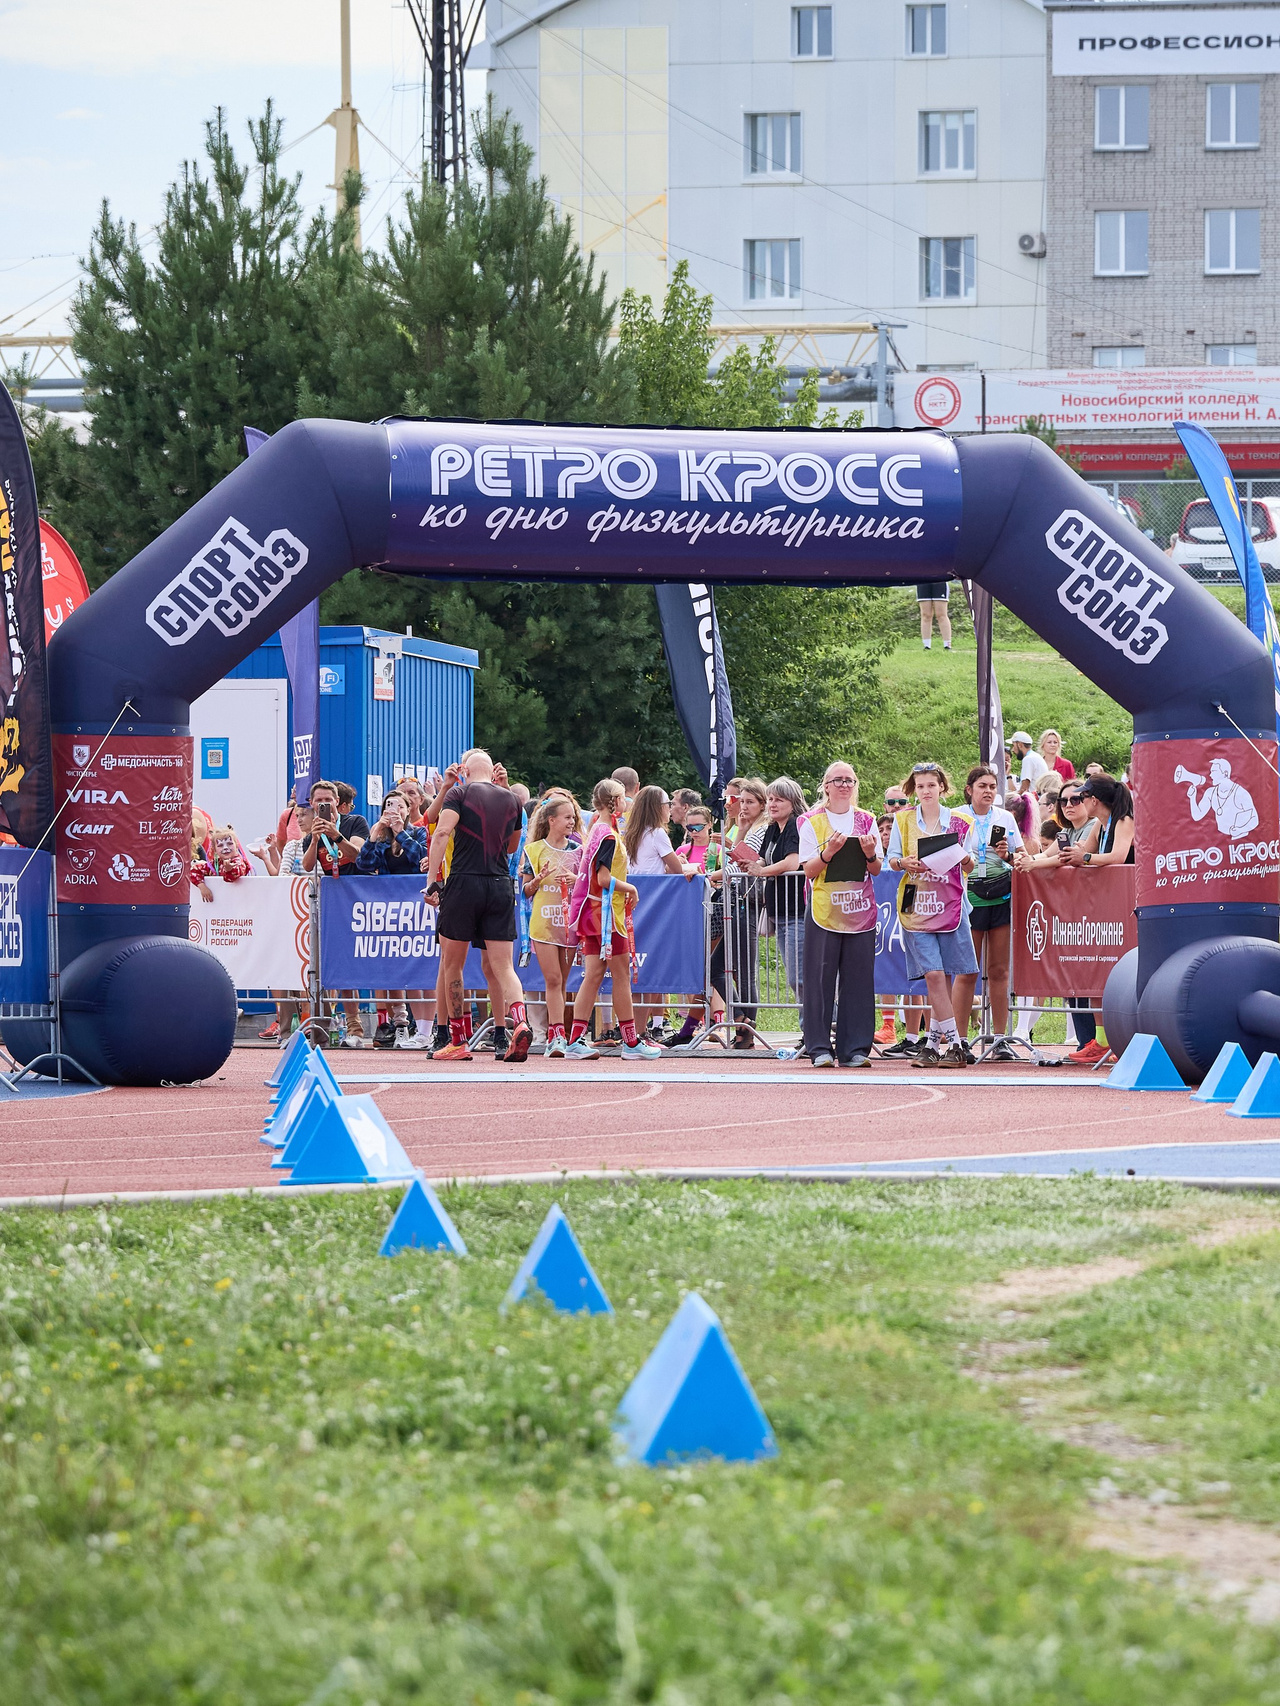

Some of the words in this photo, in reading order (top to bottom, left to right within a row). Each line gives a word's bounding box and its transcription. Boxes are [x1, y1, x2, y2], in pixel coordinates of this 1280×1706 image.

[1062, 392, 1184, 410] Новосибирский
[1189, 393, 1259, 406] колледж
[975, 412, 1087, 426] транспортных
[1092, 409, 1183, 424] технологий
[1189, 412, 1240, 421] имени
[1245, 408, 1261, 421] Н.
[1126, 453, 1170, 463] колледж
[431, 443, 658, 499] РЕТРО
[678, 449, 925, 506] КРОСС
[419, 503, 468, 529] ко
[484, 504, 569, 541] дню
[587, 503, 925, 548] физкультурника
[1053, 516, 1165, 611] СПОРТ
[154, 527, 256, 637] СПОРТ
[213, 537, 301, 630] СОЮЗ
[1065, 574, 1160, 656] СОЮЗ
[65, 770, 97, 778] ЧИСТОЕРЬЕ
[65, 789, 130, 804] VIRA
[152, 803, 183, 812] SPORT
[71, 824, 114, 835] КАНТ
[139, 821, 157, 834] EL
[325, 850, 343, 862] 60
[1155, 846, 1223, 875] РЕТРО
[64, 874, 98, 885] ADRIA
[1156, 875, 1167, 887] ко
[1172, 873, 1197, 888] дню
[832, 891, 862, 903] СПОРТ
[843, 899, 869, 912] СОЮЗ
[916, 903, 943, 913] СОЮЗ
[210, 919, 253, 927] ФЕДЕРАЦИЯ
[210, 928, 253, 936] ТРИАТЛОНА
[210, 938, 238, 946] РОССИИ
